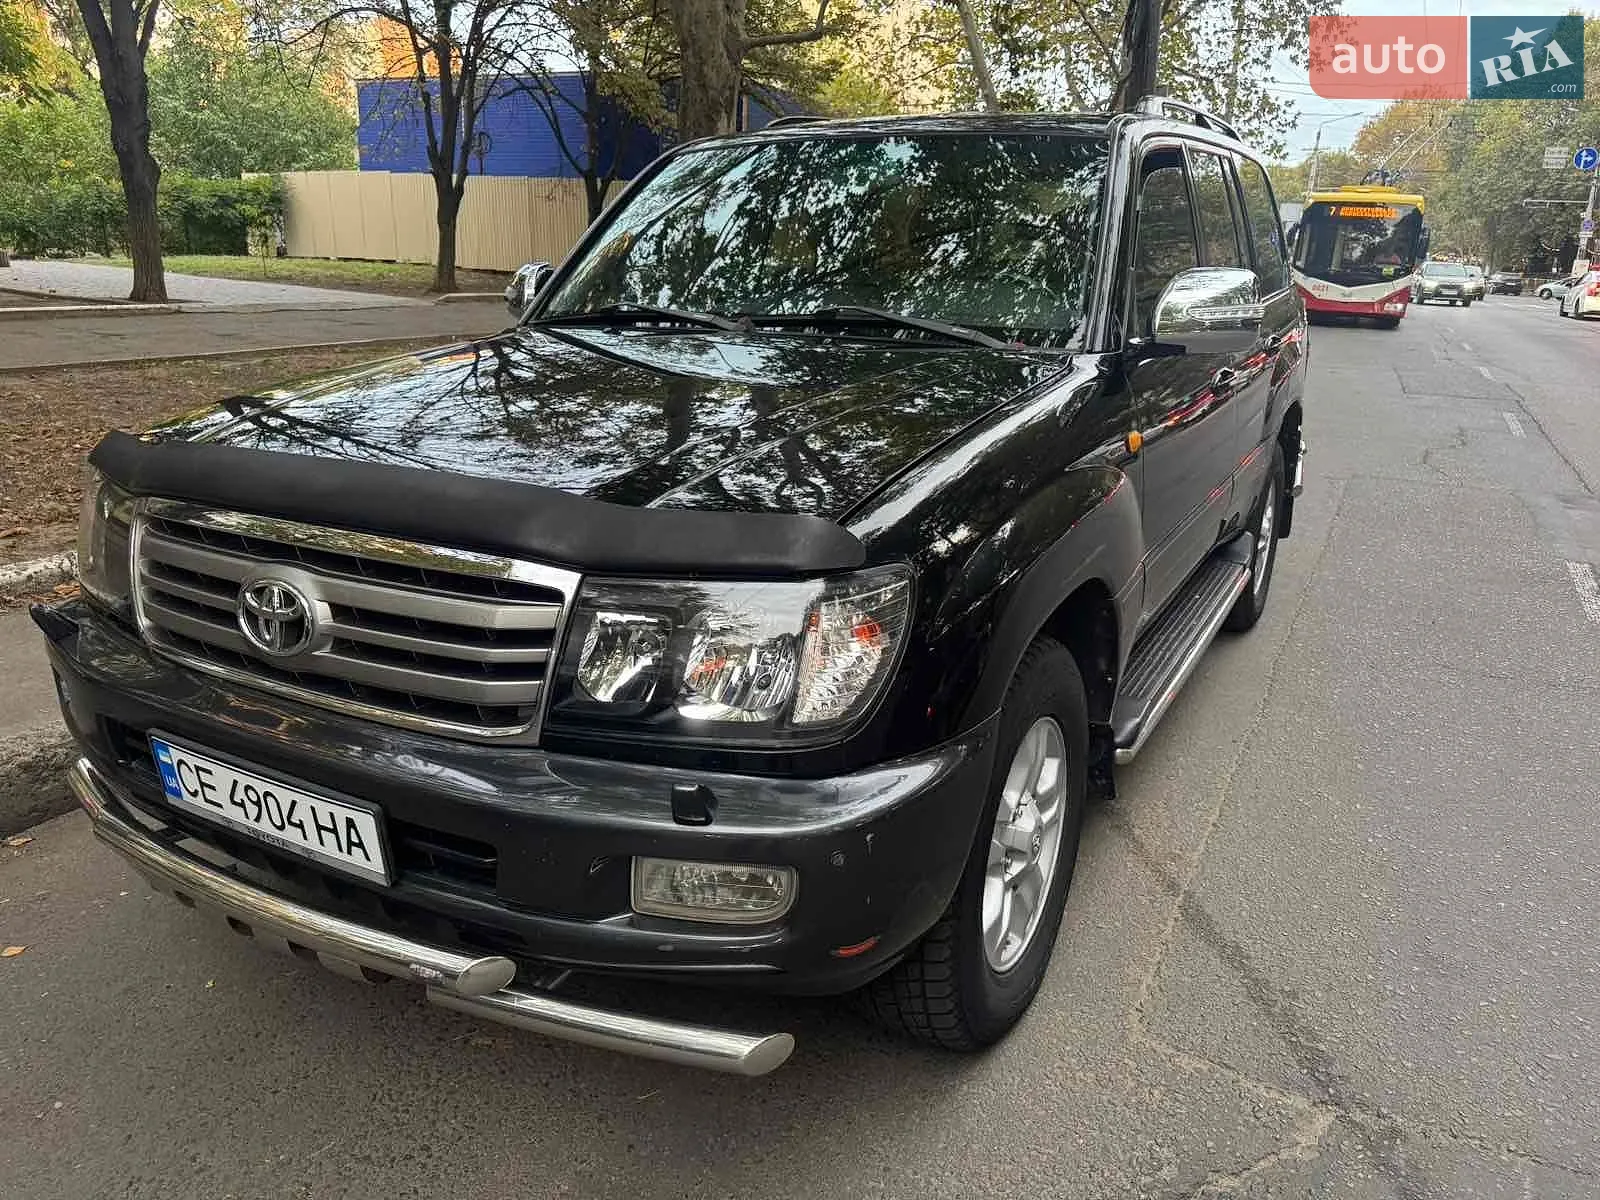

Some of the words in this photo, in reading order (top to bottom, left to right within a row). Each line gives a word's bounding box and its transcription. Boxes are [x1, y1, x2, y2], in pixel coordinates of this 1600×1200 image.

[176, 758, 225, 809] CE
[229, 778, 308, 841] 4904
[310, 804, 371, 862] HA
